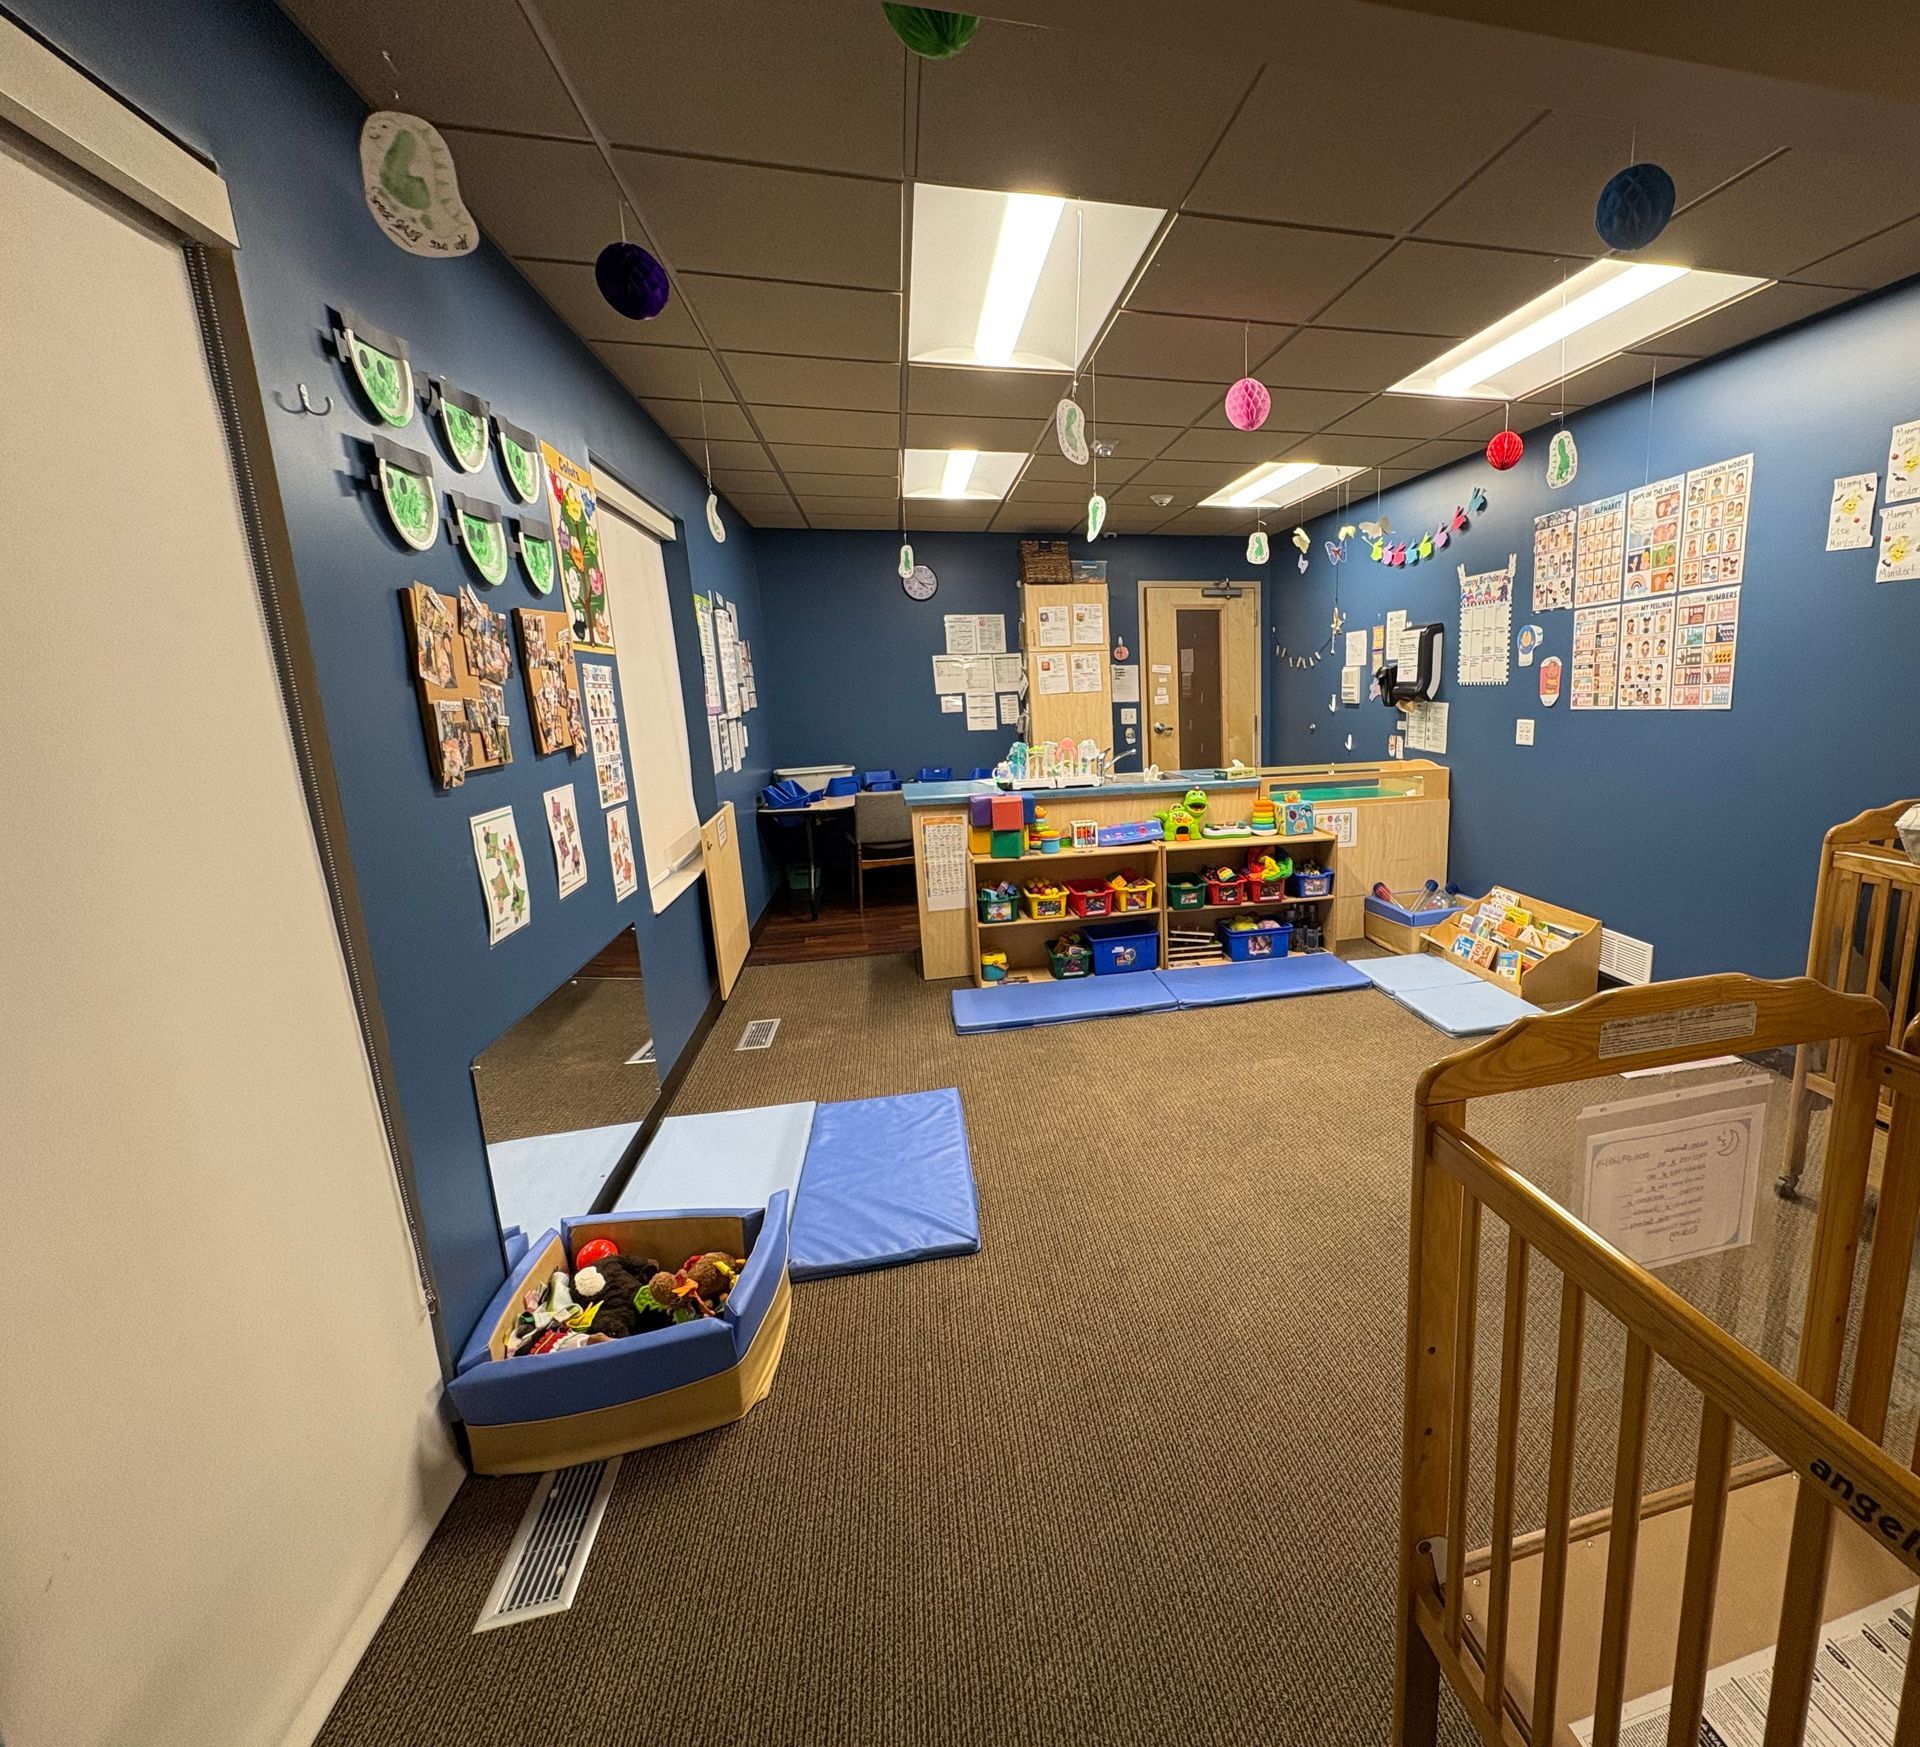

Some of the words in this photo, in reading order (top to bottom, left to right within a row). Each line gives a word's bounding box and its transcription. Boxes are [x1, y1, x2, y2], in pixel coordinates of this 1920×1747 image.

[1700, 464, 1726, 478] COMMON
[1727, 458, 1749, 469] WORDS
[1632, 493, 1645, 502] DAYS
[1645, 490, 1652, 498] OF
[1653, 488, 1663, 496] THE
[1664, 483, 1680, 493] WEEK
[1594, 500, 1622, 515] ALPHABET
[1706, 591, 1738, 602] NUMBERS
[1640, 603, 1650, 611] MY
[1650, 600, 1673, 610] FEELINGS
[1809, 1458, 1920, 1562] angel
